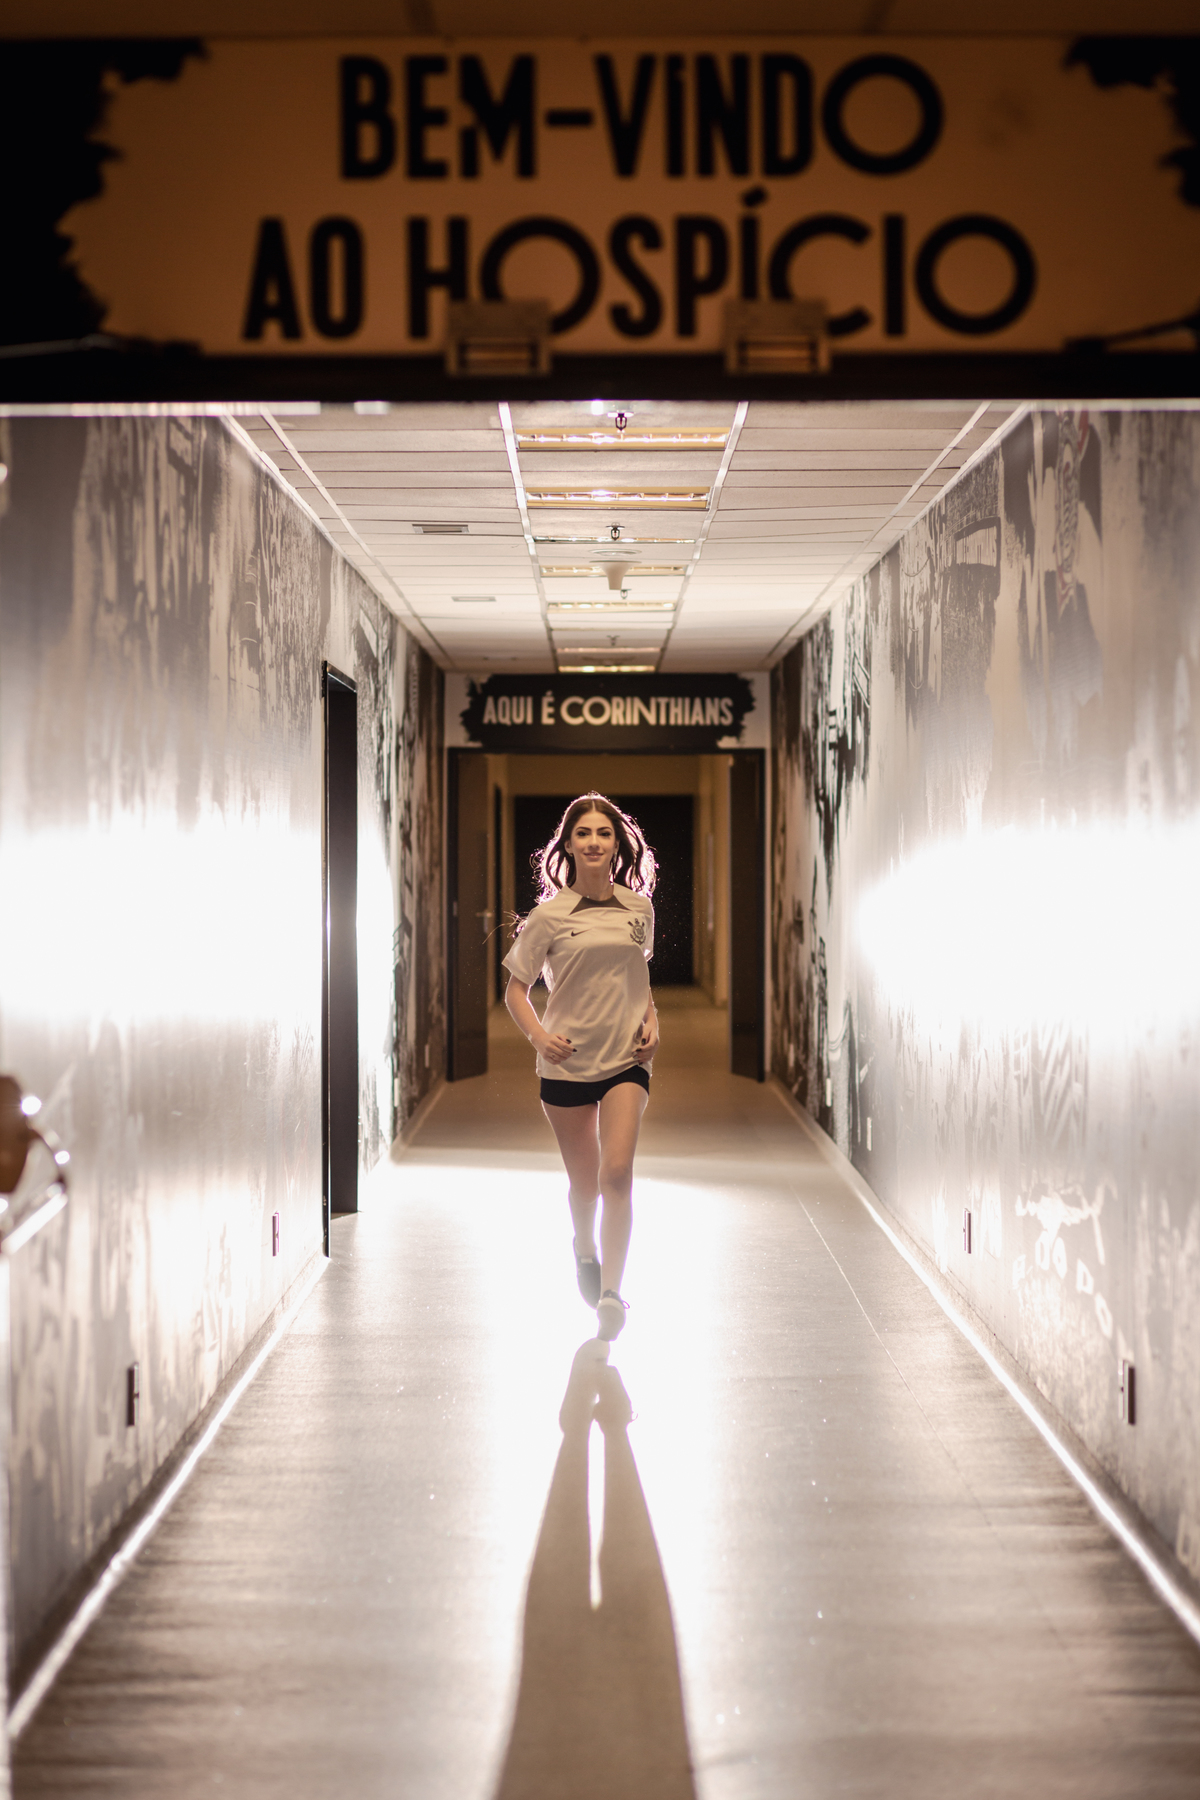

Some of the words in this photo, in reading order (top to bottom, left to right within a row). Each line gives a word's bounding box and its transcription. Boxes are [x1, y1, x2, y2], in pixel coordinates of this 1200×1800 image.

[339, 52, 945, 180] BEM-VINDO
[241, 214, 365, 341] AO
[407, 184, 1039, 341] HOSPÍCIO
[482, 695, 533, 727] AQUI
[541, 689, 556, 726] É
[560, 695, 734, 726] CORINTHIANS
